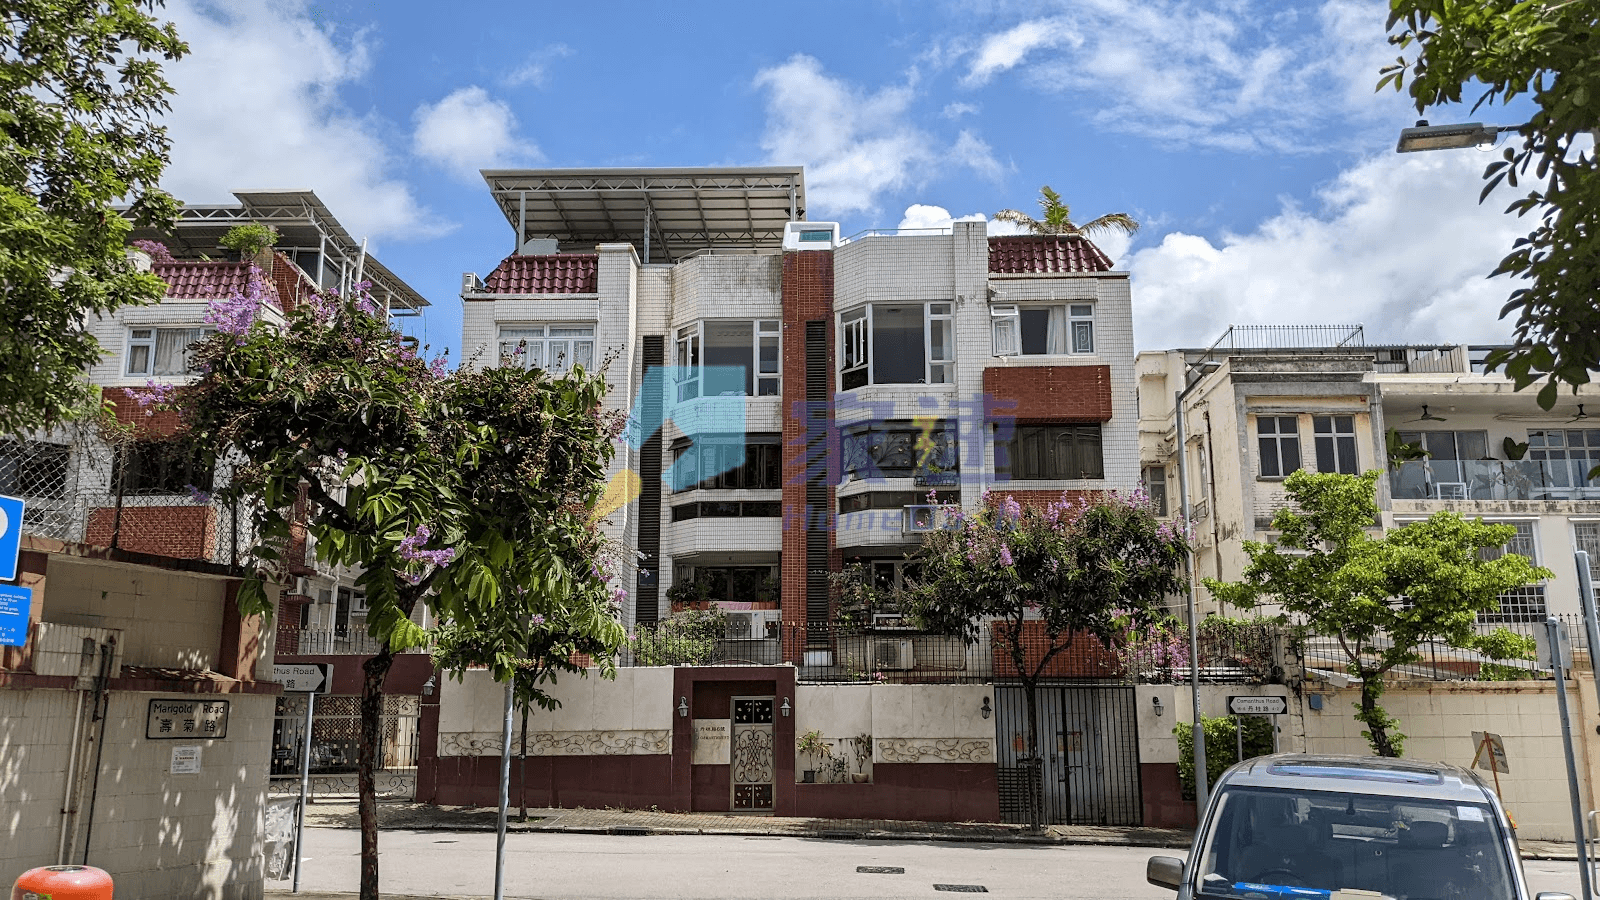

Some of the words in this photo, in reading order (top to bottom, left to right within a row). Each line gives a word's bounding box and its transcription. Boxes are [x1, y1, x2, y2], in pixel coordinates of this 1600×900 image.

[292, 667, 315, 675] Road
[153, 703, 193, 715] Marigold
[202, 704, 225, 714] Road
[159, 718, 216, 733] 壽菊路
